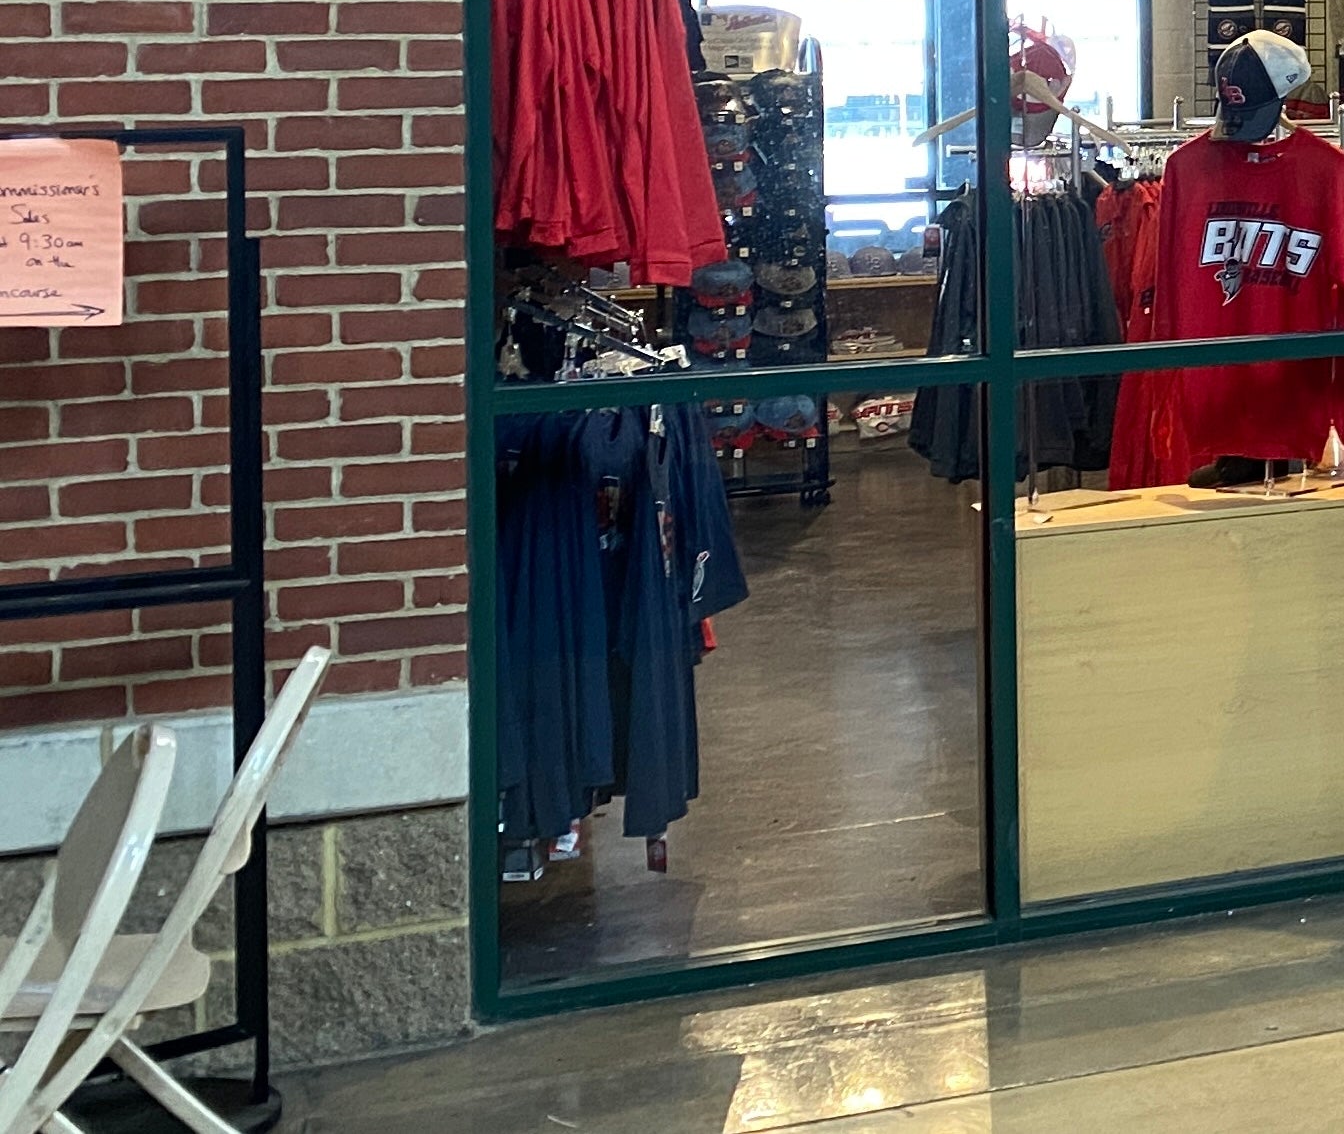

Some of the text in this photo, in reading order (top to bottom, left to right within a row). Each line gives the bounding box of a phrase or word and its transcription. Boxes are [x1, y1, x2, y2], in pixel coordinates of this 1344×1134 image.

[0, 174, 100, 197] ommissioner's
[1198, 217, 1323, 279] BATS
[25, 257, 43, 267] on
[0, 287, 62, 299] ncourse
